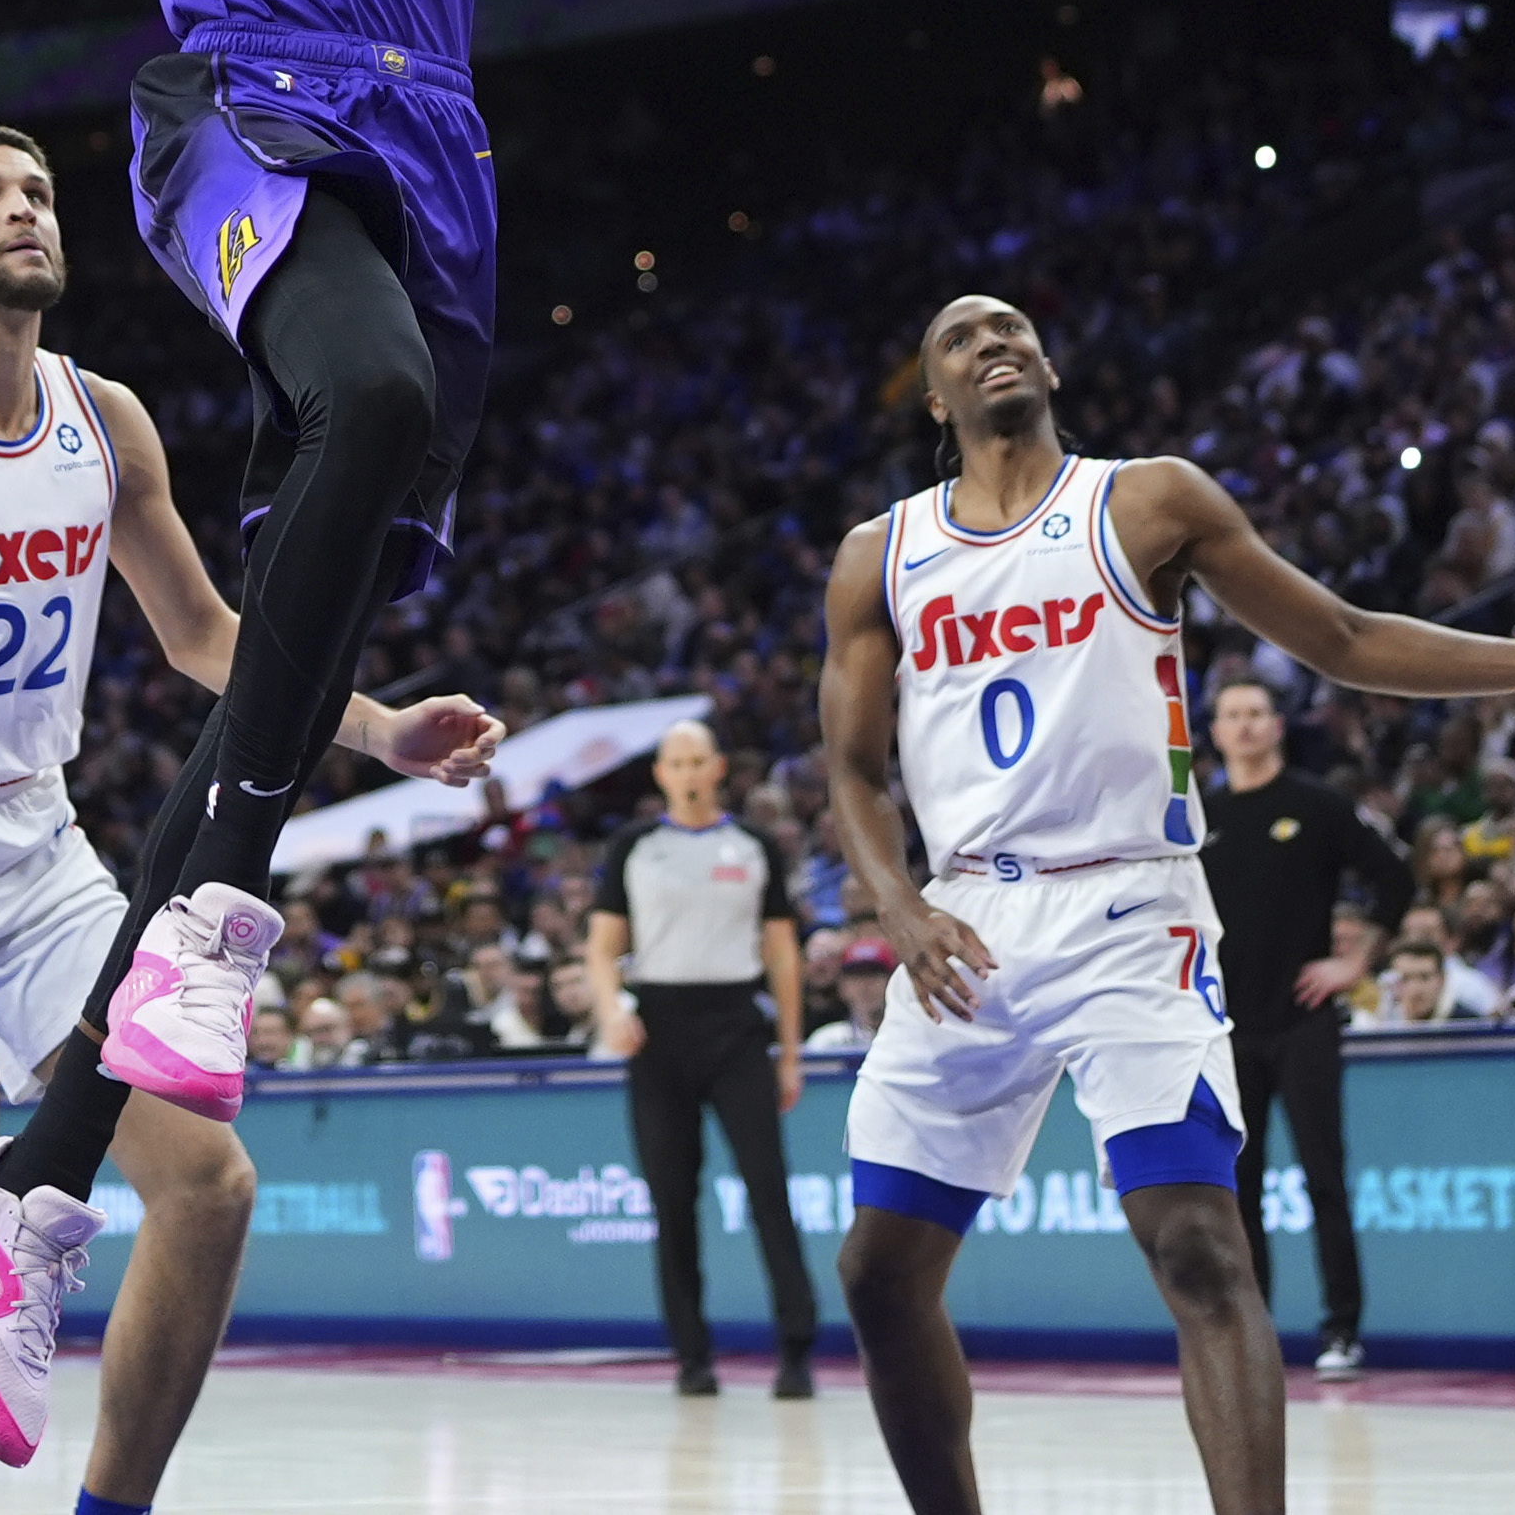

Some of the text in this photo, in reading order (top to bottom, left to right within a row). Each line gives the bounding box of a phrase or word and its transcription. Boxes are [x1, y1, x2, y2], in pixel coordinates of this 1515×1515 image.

[54, 459, 101, 472] crypto.com
[1026, 543, 1084, 556] crypto.com
[912, 592, 1105, 672] Sixers
[979, 677, 1035, 770] 0
[1168, 926, 1226, 1025] 76
[520, 1164, 655, 1217] DashPa
